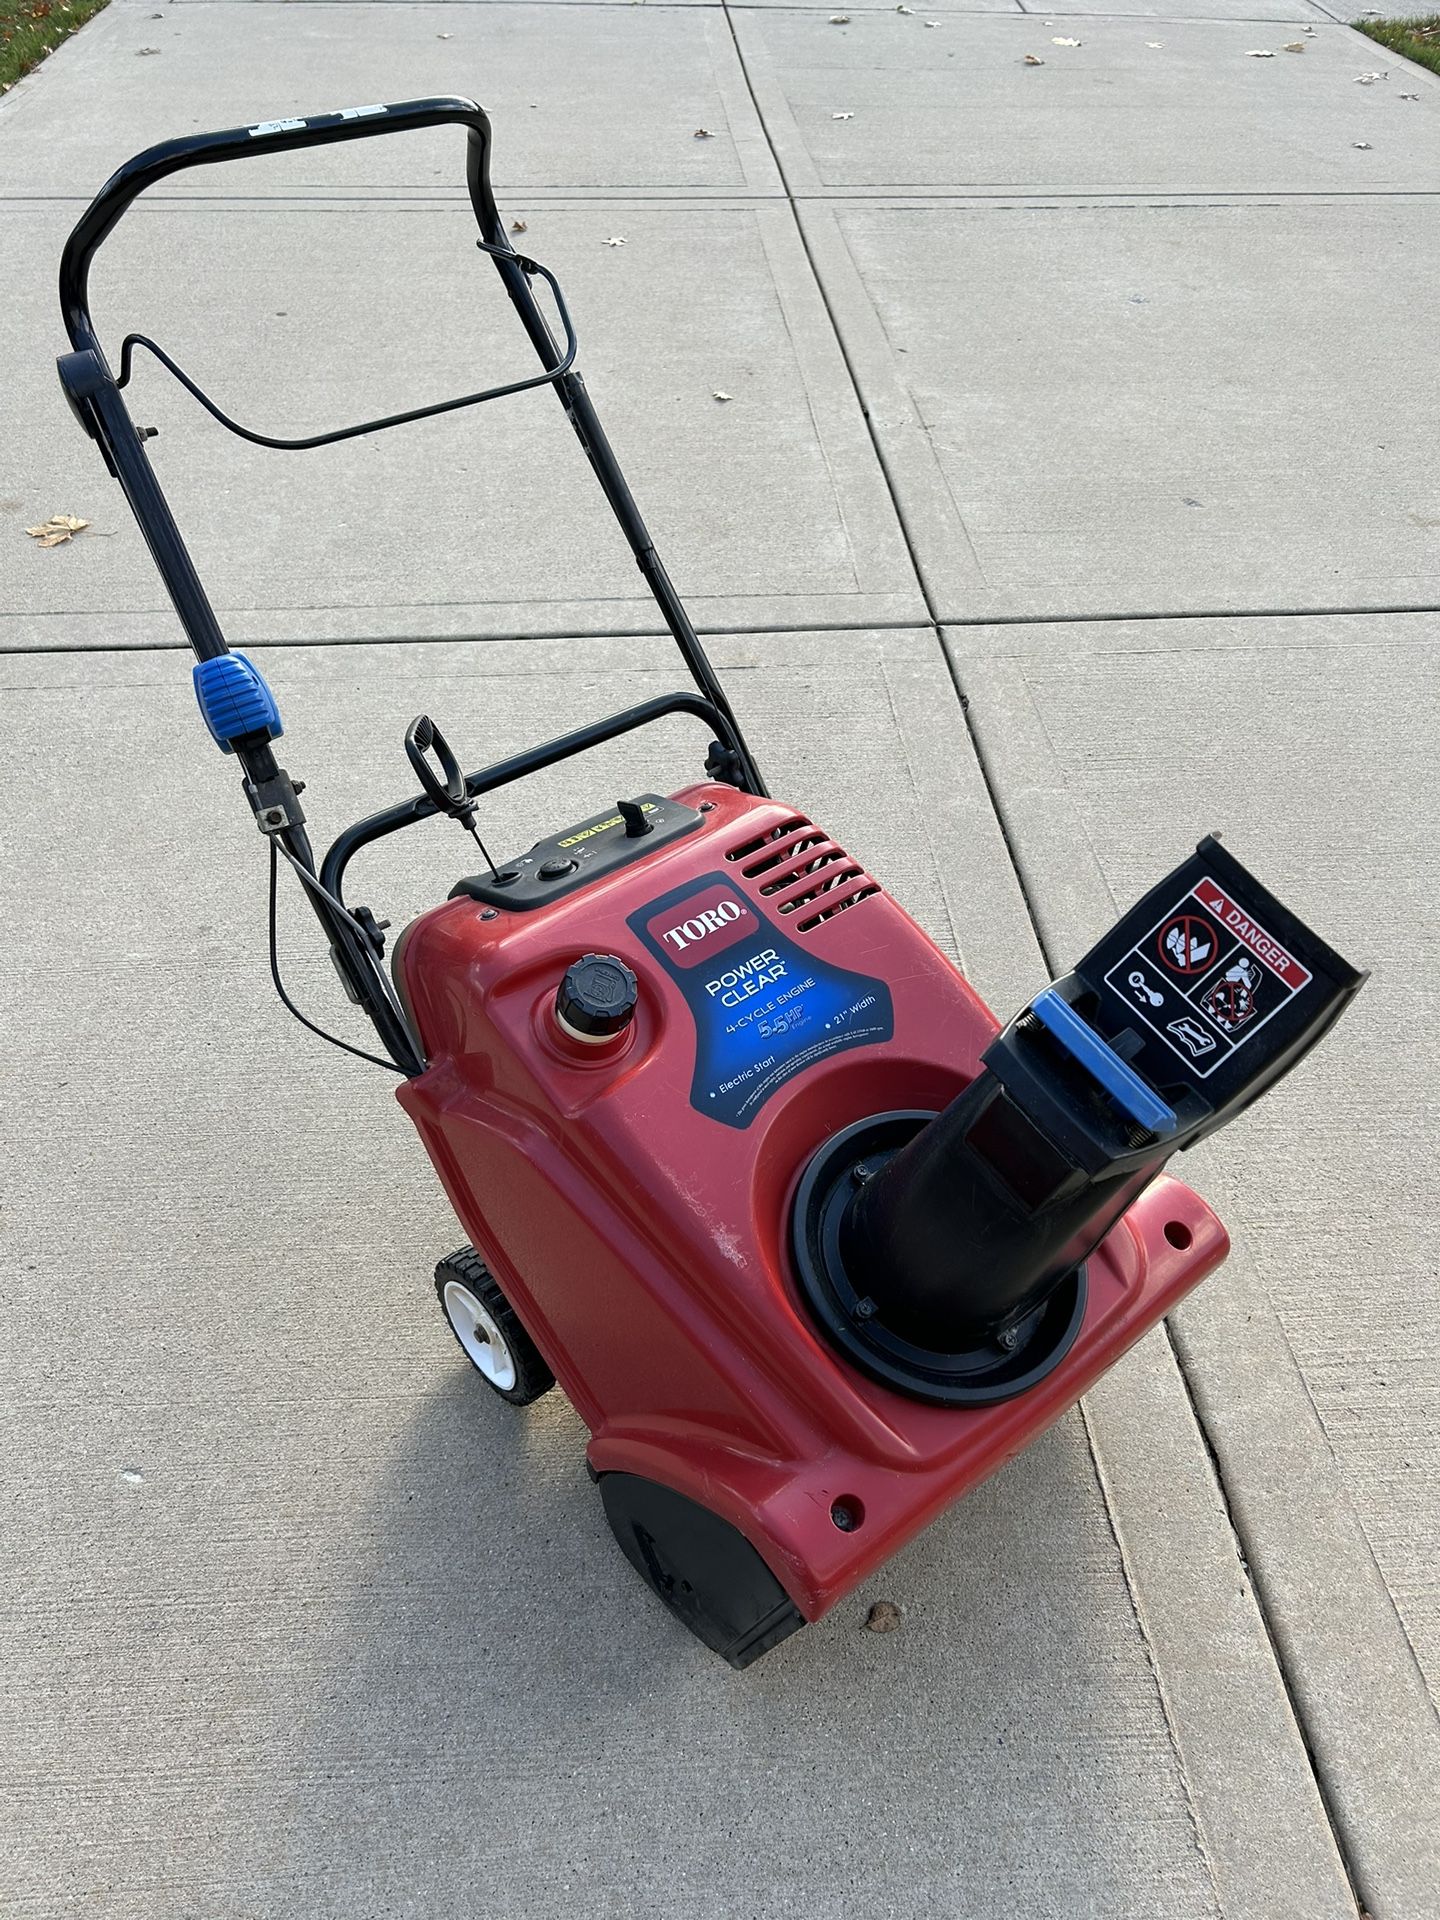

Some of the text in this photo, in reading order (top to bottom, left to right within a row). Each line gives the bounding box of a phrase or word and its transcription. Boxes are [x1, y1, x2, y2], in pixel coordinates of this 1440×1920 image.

[662, 901, 741, 951] TORO
[1225, 910, 1291, 972] DANGER
[704, 948, 781, 998] POWER
[721, 964, 788, 1009] CLEAR
[726, 977, 816, 1034] 4-CYCLE ENGINE
[833, 995, 876, 1025] 21" Width
[719, 1069, 753, 1095] Electric
[753, 1055, 776, 1078] Start
